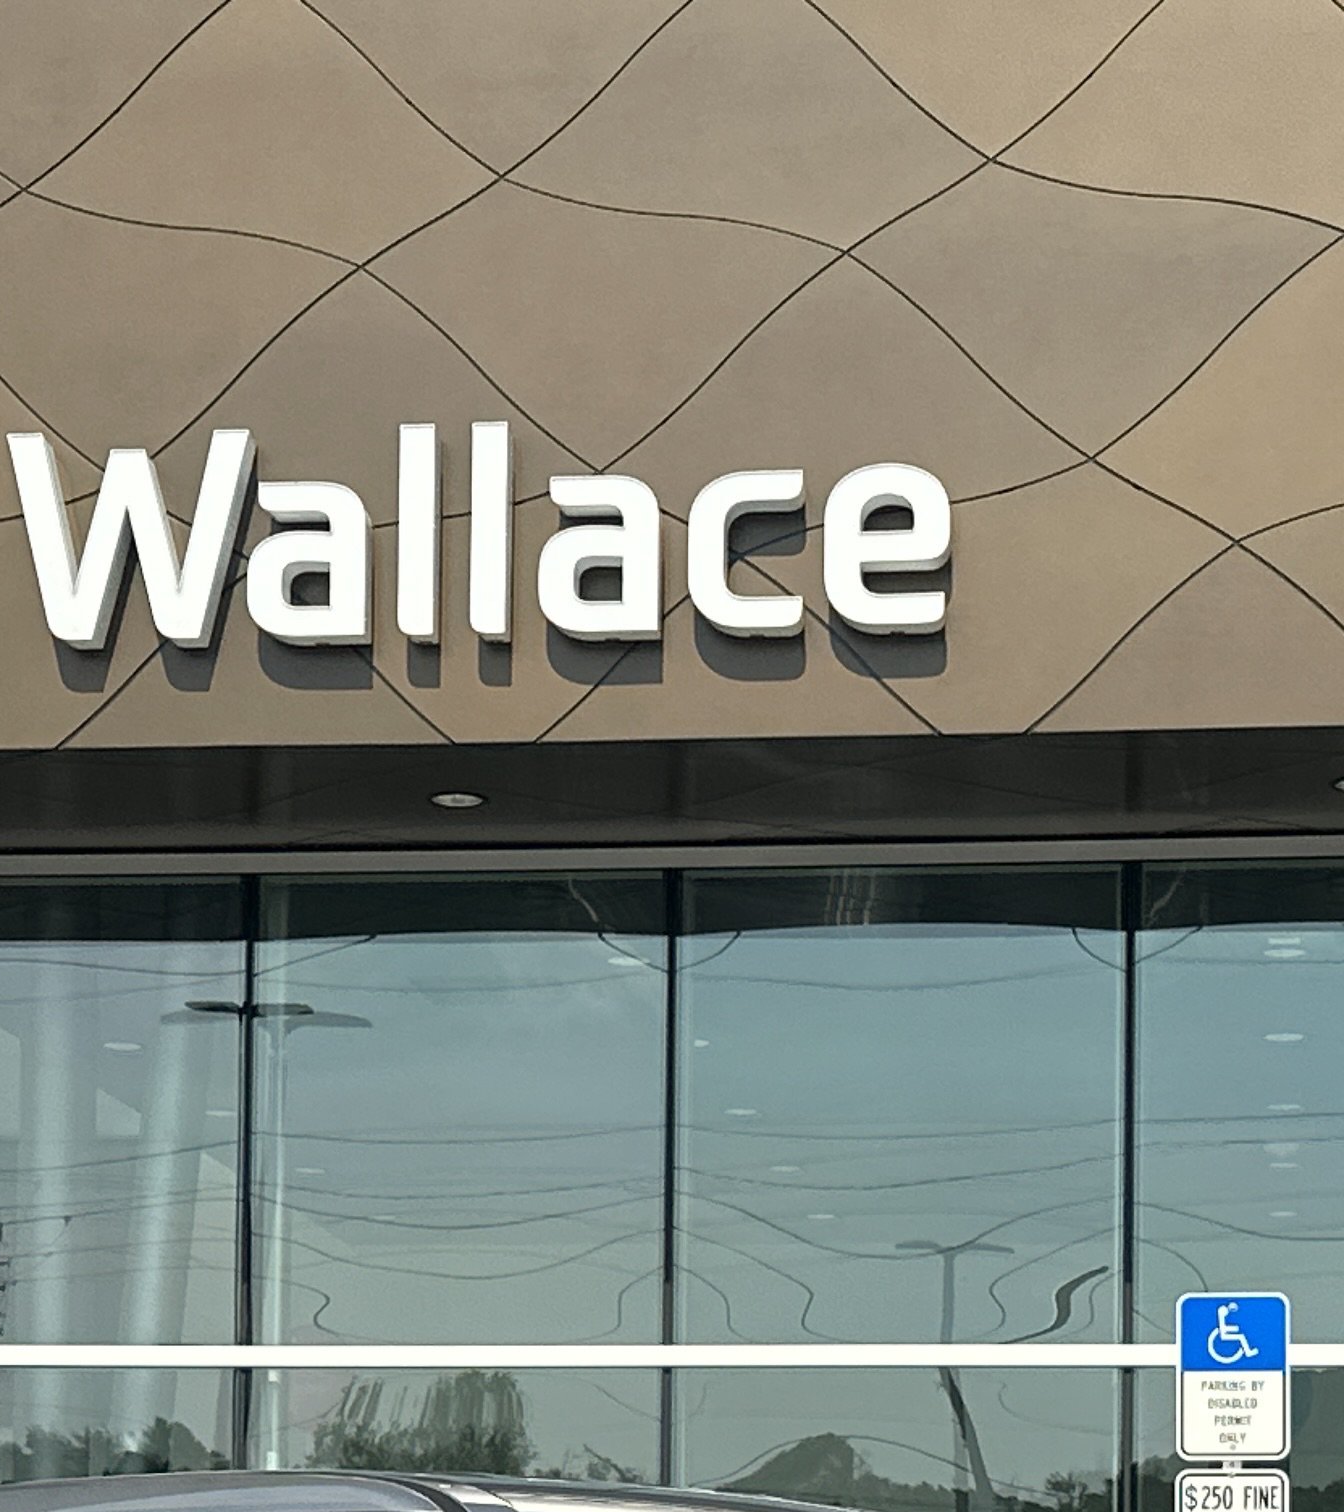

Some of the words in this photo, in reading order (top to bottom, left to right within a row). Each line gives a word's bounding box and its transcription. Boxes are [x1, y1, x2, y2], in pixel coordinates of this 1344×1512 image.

[6, 421, 950, 650] Wallace
[1251, 1381, 1264, 1391] BY
[1185, 1484, 1233, 1512] $250
[1243, 1485, 1280, 1510] FINE
